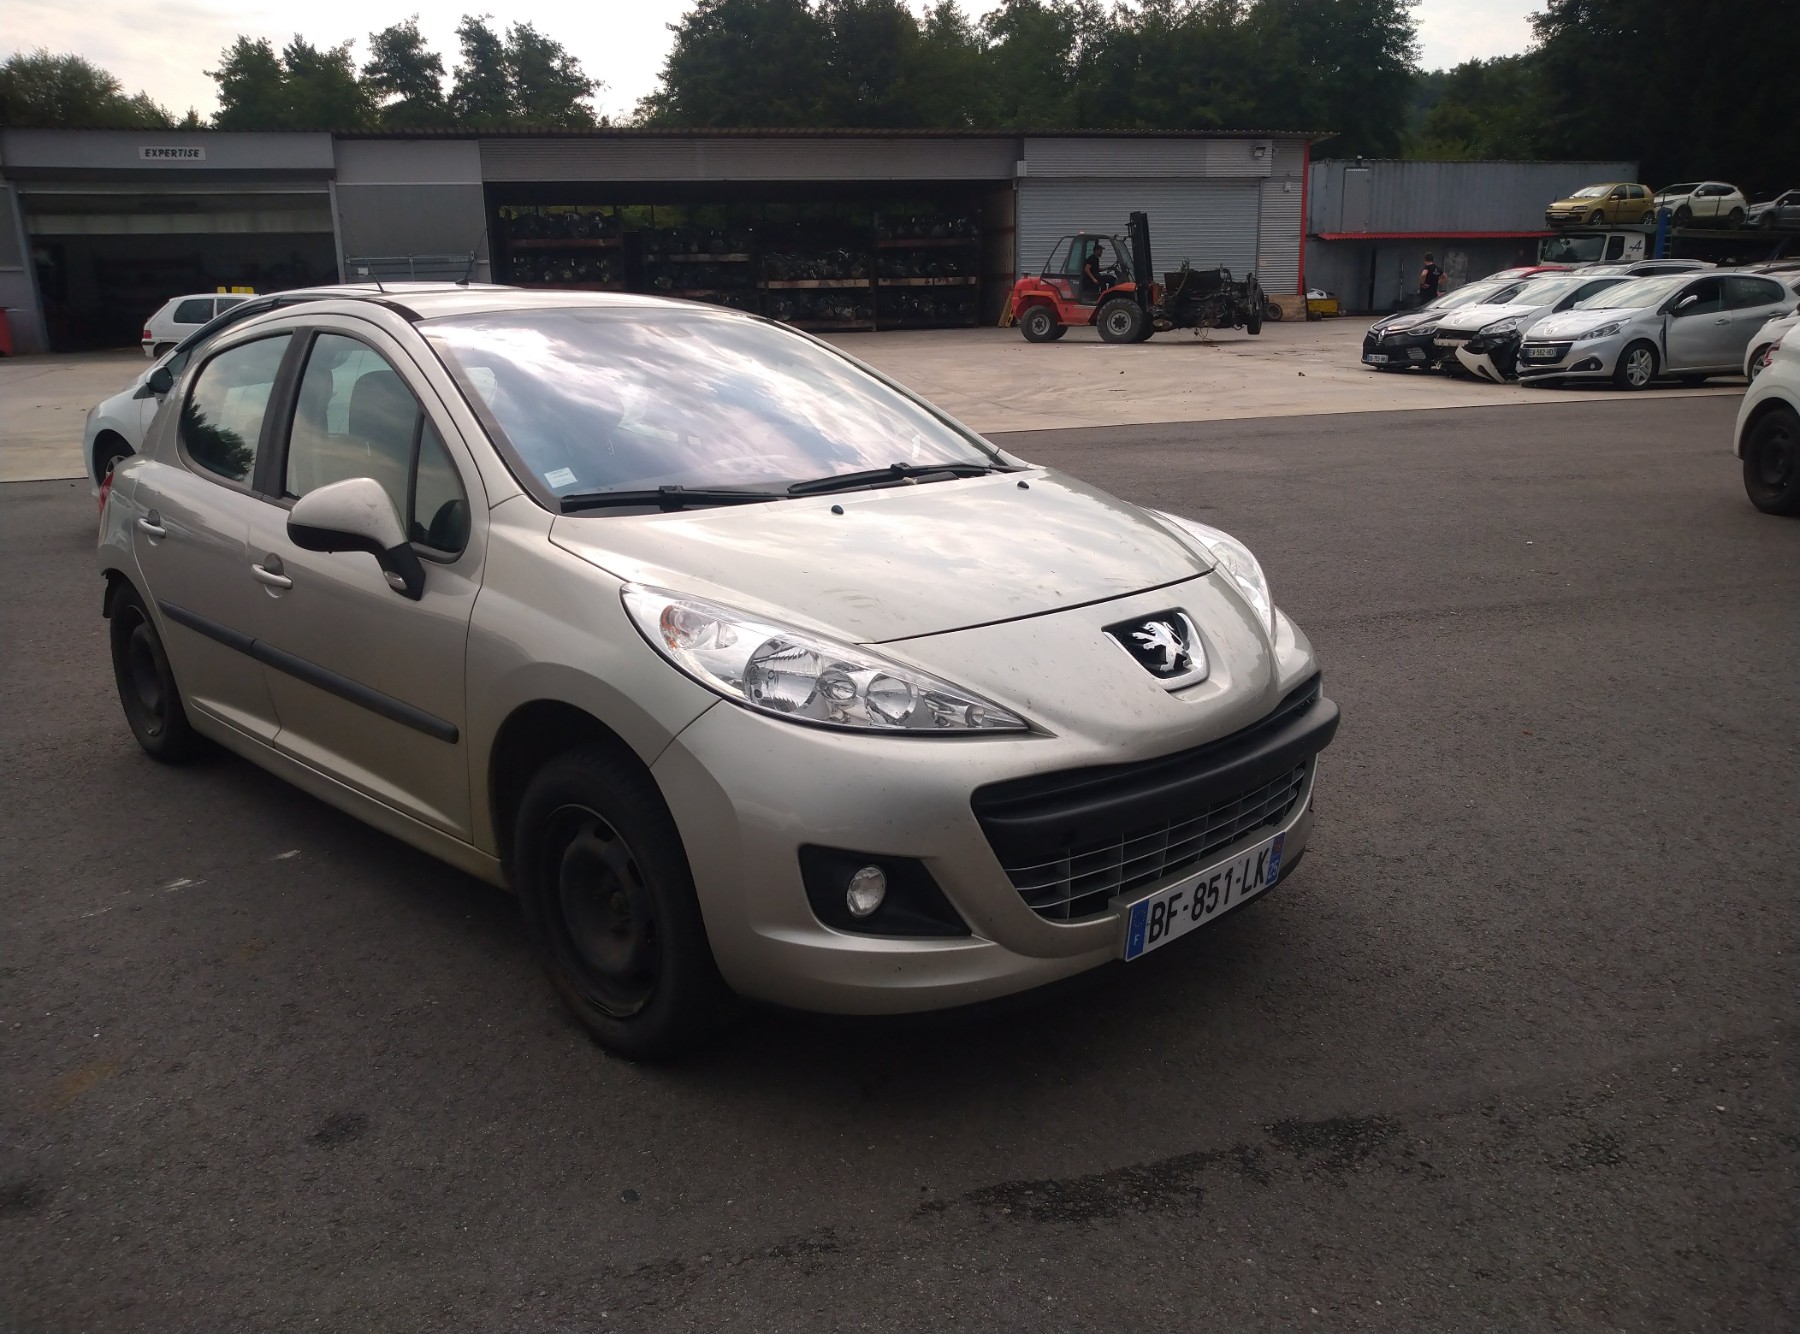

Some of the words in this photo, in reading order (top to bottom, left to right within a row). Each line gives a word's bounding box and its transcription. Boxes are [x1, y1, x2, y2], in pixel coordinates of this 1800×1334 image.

[144, 148, 200, 158] EXPERTISE
[1133, 933, 1141, 947] F
[1148, 847, 1270, 944] BF-851-LK
[1267, 859, 1280, 880] 25
